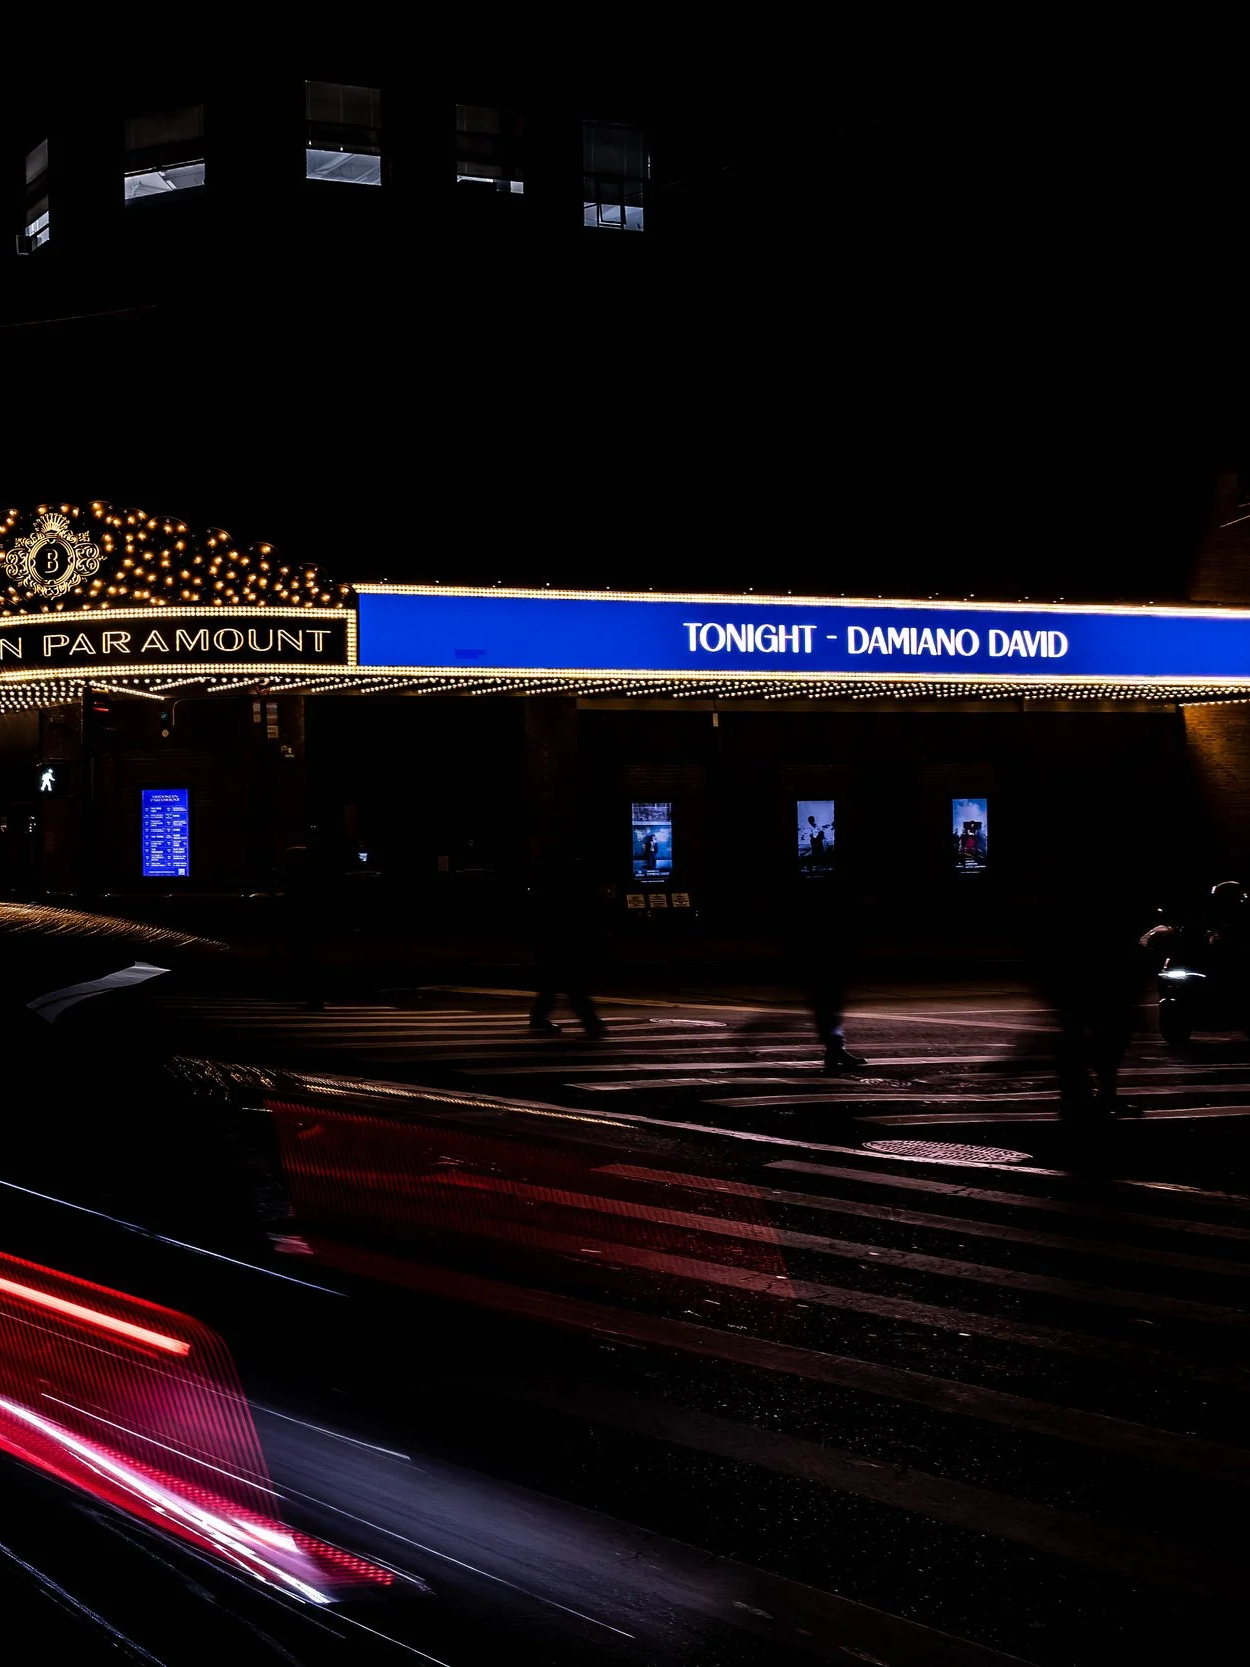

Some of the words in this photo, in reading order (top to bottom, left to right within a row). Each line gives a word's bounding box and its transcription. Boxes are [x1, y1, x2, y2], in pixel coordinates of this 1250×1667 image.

[44, 548, 59, 574] B
[43, 628, 332, 657] PARAMOUNT
[682, 622, 818, 654] TONIGHT
[847, 625, 980, 657] DAMIANO
[988, 629, 1069, 658] DAVID
